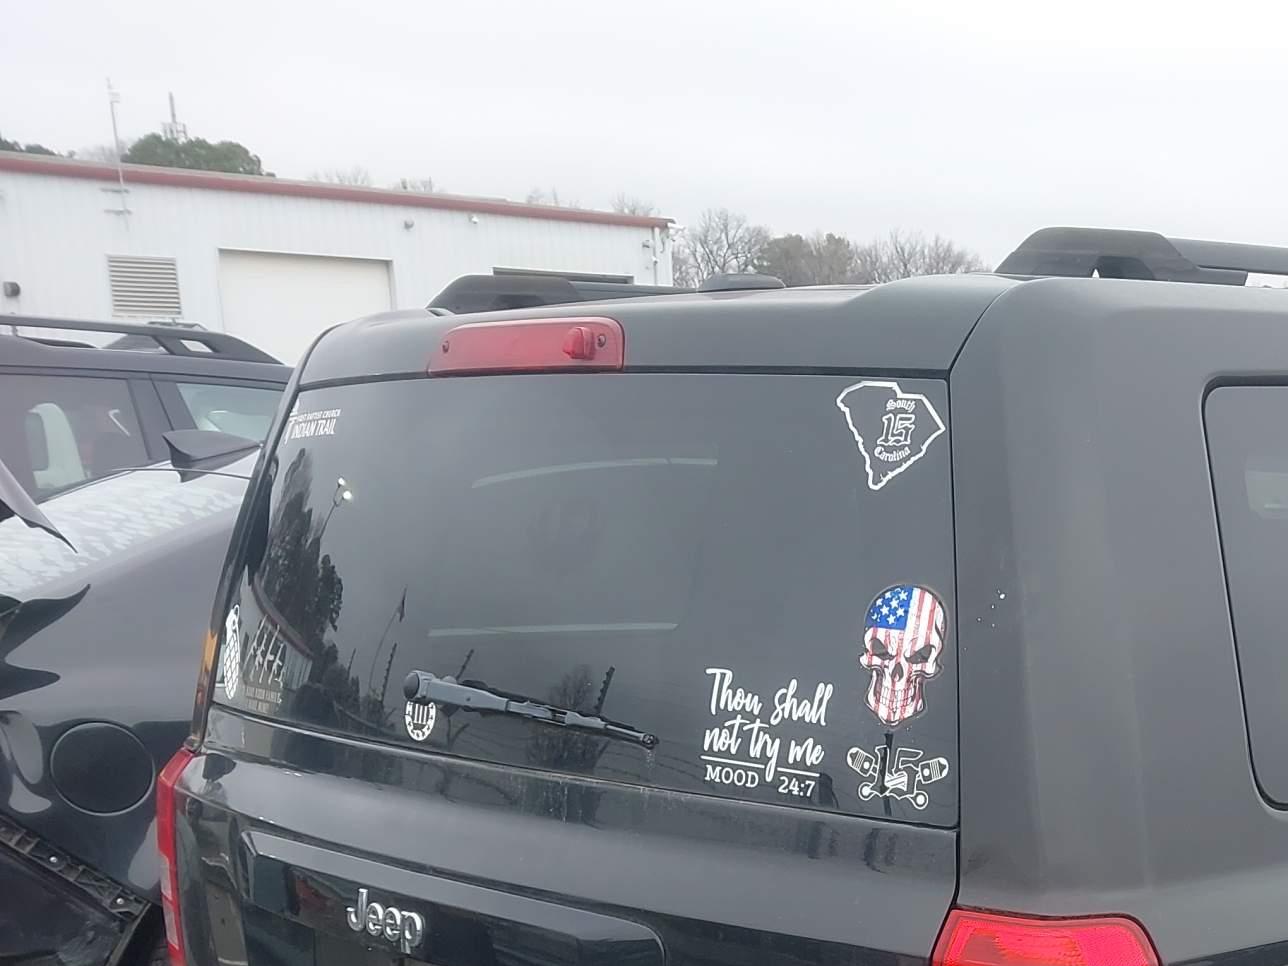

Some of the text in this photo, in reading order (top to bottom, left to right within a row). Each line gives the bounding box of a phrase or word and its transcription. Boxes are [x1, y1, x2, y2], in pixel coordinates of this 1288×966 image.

[322, 408, 341, 418] CHURCH
[886, 399, 915, 412] South
[291, 418, 336, 439] INDIAN TRAIL
[877, 413, 915, 446] 15
[874, 446, 910, 461] Carolina
[705, 667, 833, 726] Thou shall
[703, 714, 825, 782] not try me
[704, 764, 815, 797] MOOD 24:7
[346, 888, 424, 954] Jeep
